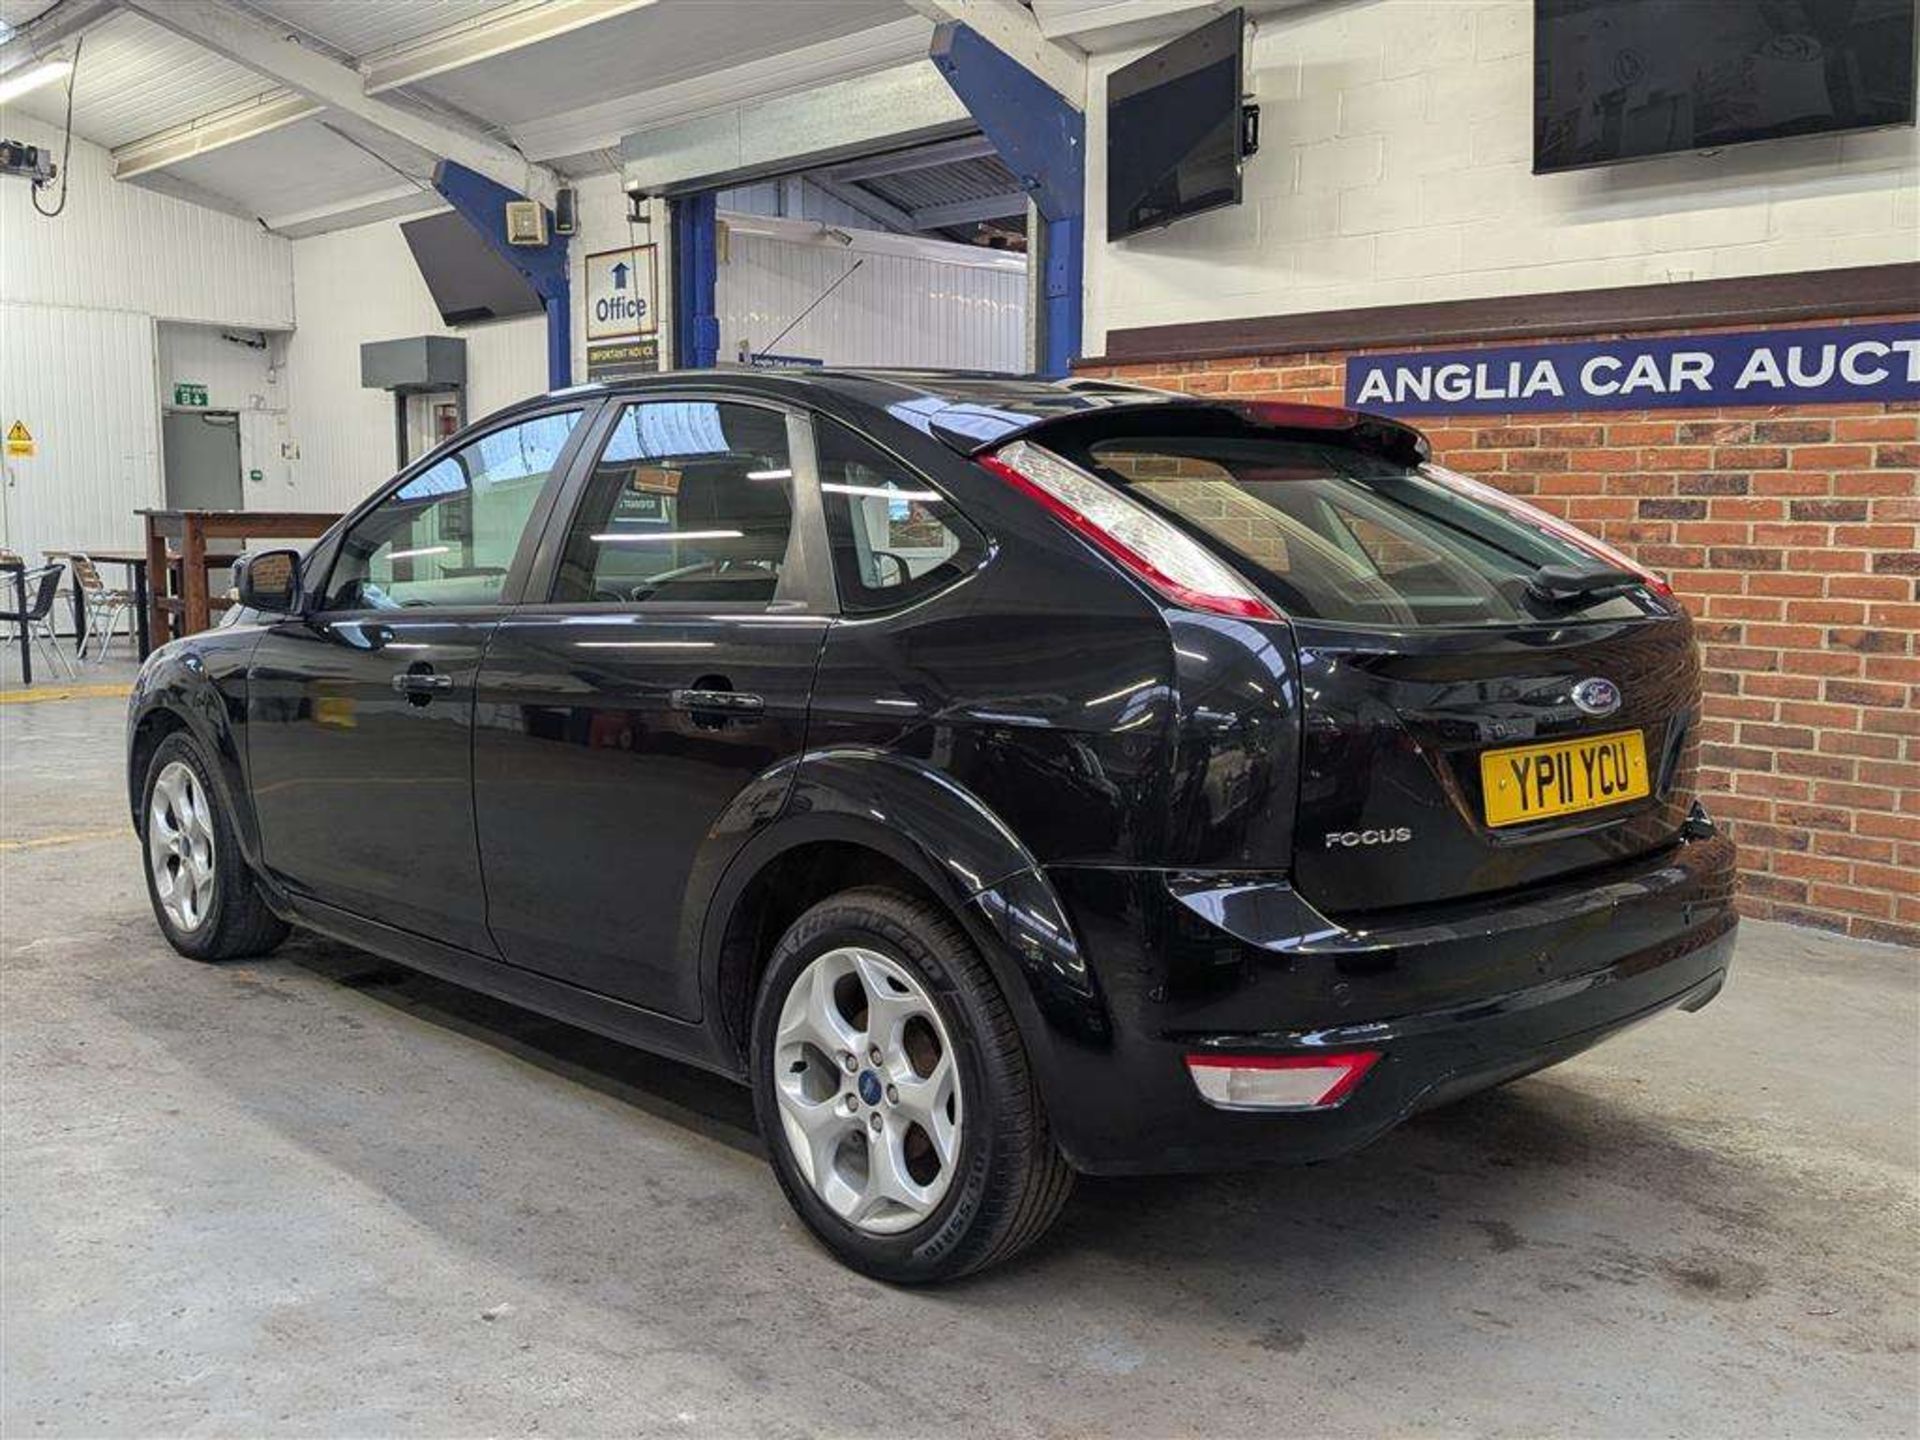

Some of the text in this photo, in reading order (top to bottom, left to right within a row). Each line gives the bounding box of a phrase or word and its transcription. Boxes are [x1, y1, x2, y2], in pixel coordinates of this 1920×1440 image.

[596, 296, 646, 321] Office
[1356, 340, 1920, 404] ANGLIA CAR AUCT
[1510, 742, 1628, 811] YP11 YCU
[1325, 828, 1411, 848] FOCUS
